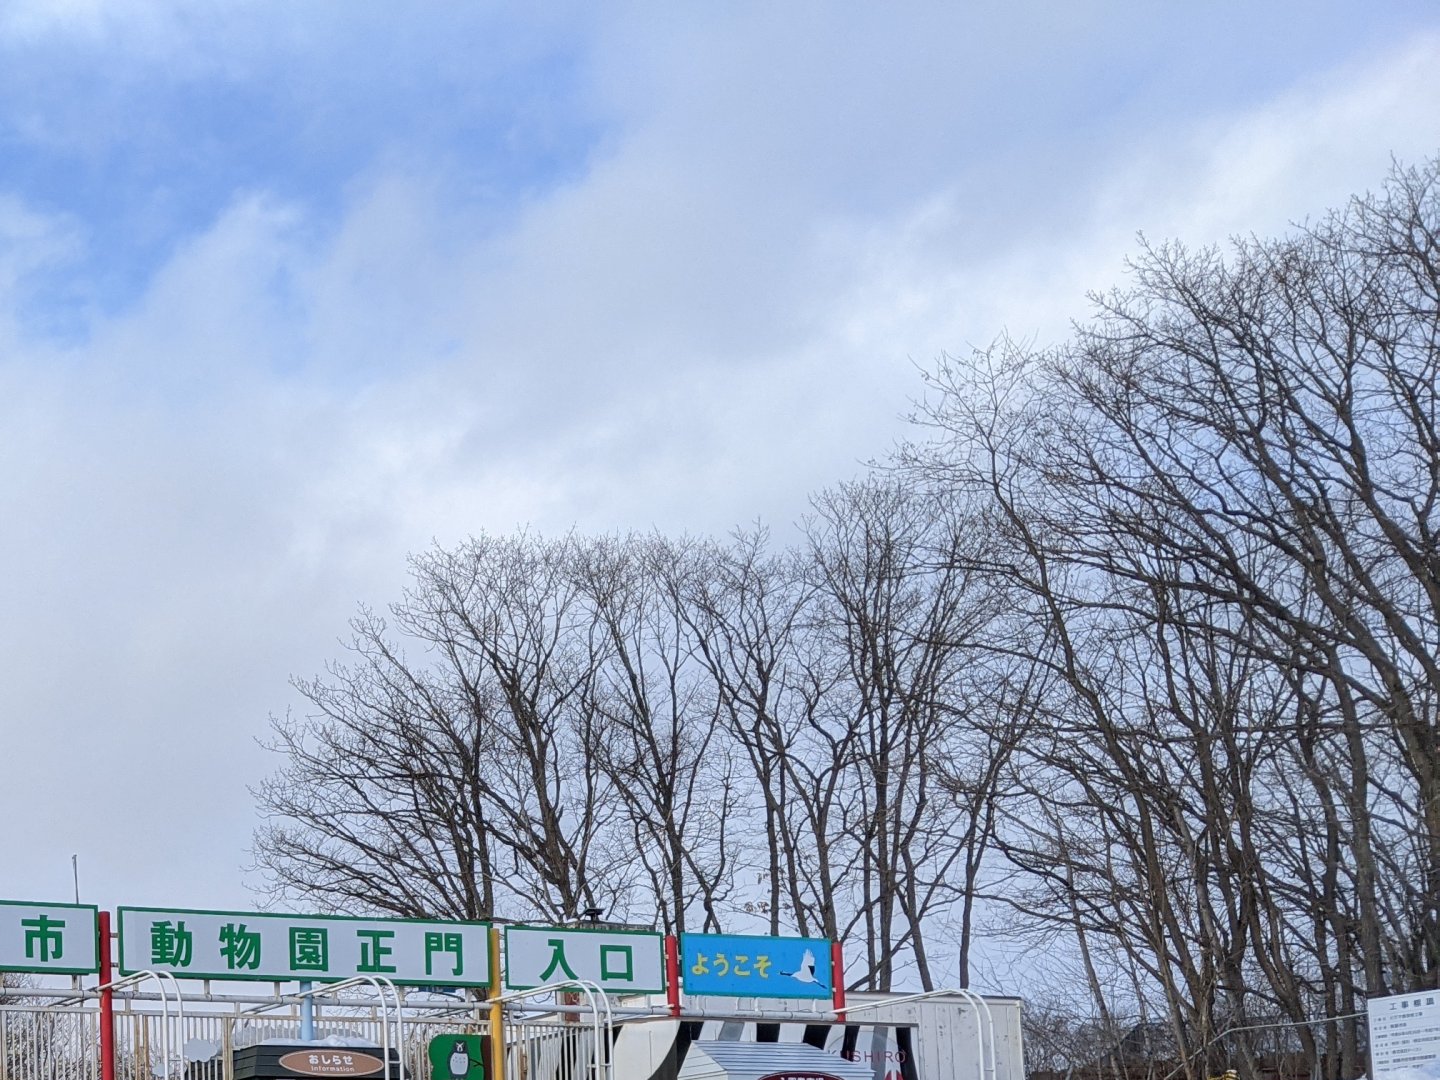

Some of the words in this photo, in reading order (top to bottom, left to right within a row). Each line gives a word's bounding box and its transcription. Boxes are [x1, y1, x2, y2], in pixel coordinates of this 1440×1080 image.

[150, 920, 464, 977] 動物園正門
[539, 938, 635, 982] 入口
[691, 952, 772, 979] ようこそ
[308, 1054, 354, 1065] おしらせ
[311, 1065, 355, 1073] Information
